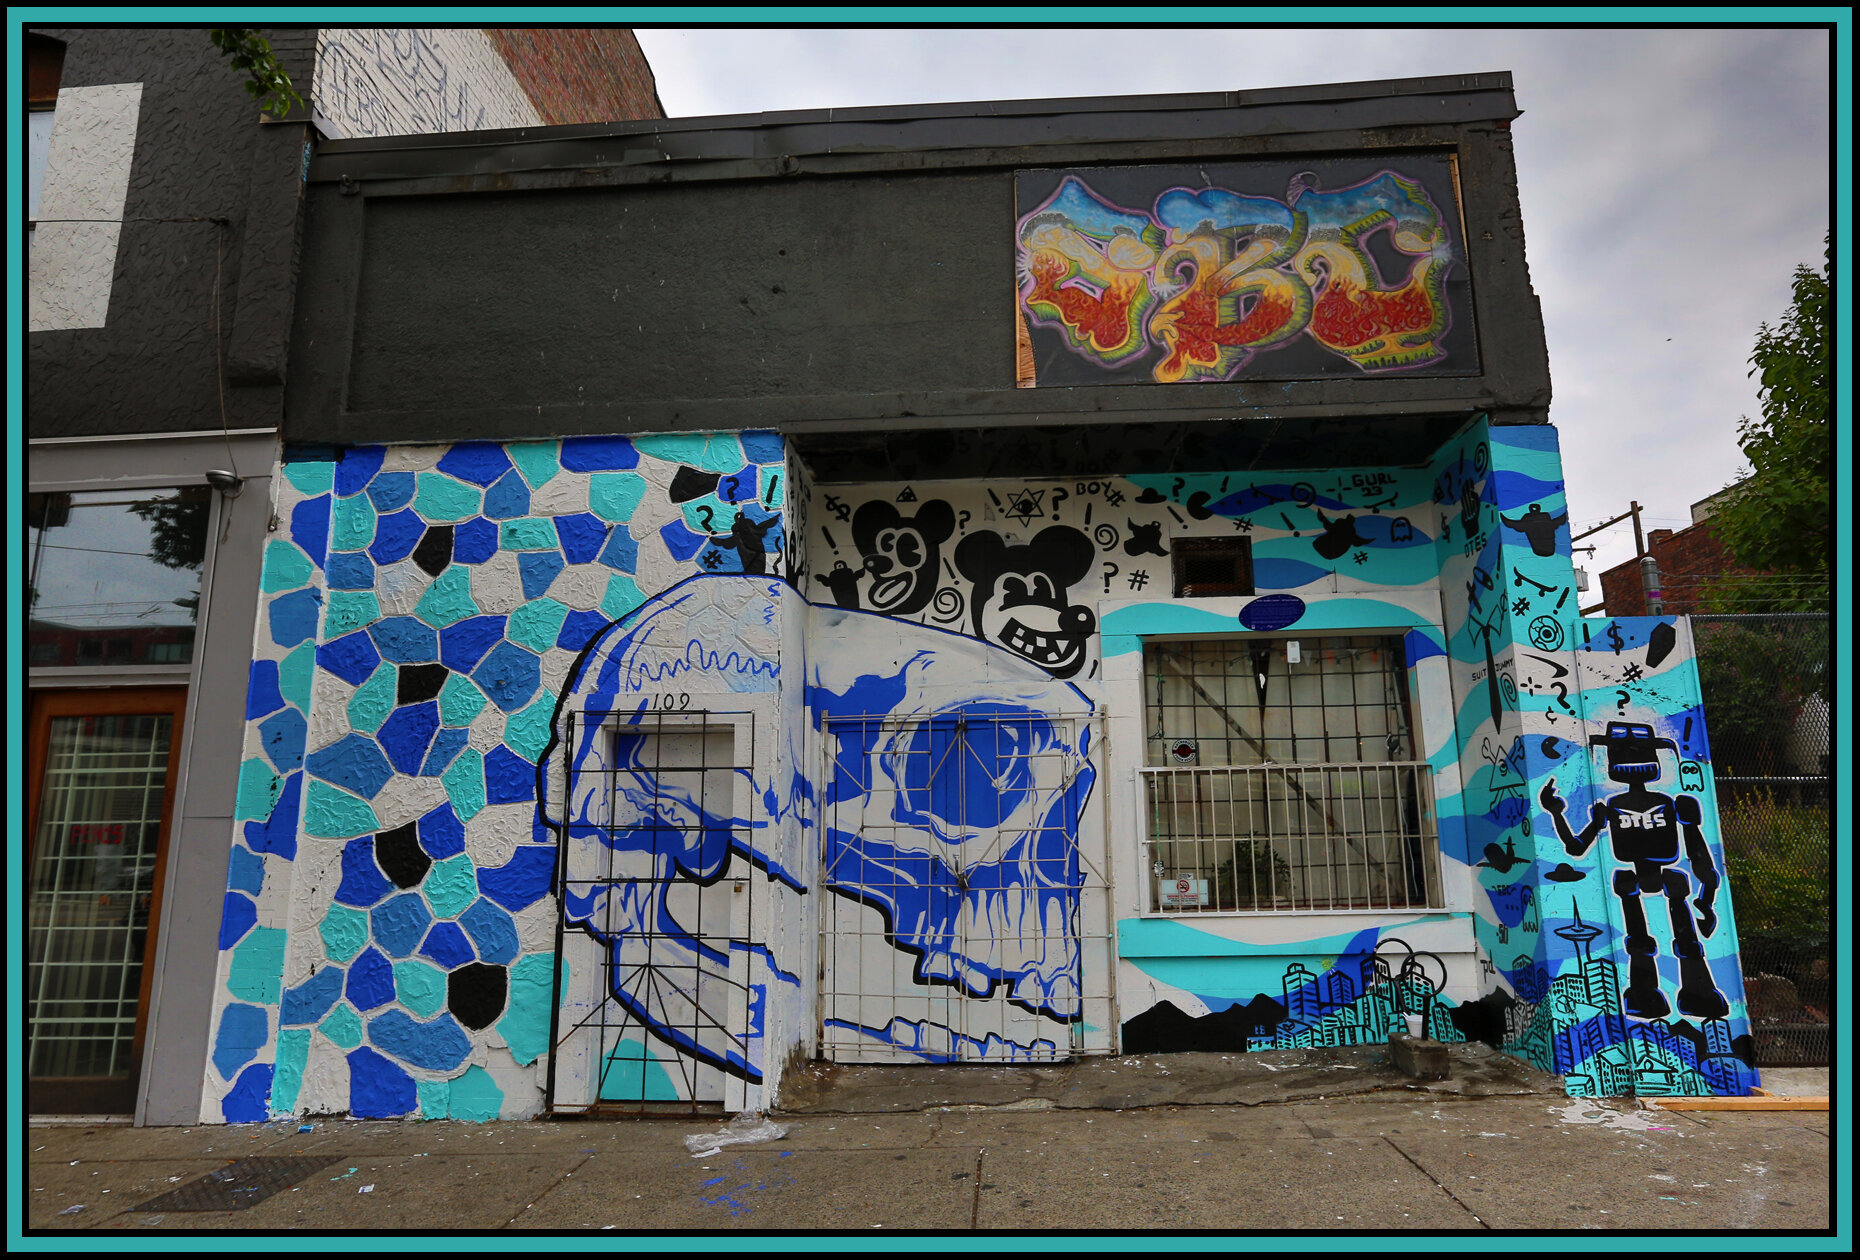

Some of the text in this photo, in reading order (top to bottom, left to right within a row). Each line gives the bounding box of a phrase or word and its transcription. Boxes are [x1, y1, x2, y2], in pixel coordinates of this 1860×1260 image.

[1351, 472, 1398, 488] GURL
[1076, 481, 1112, 499] BOY
[1464, 531, 1488, 558] DTES
[1471, 668, 1487, 682] SUIT
[652, 692, 690, 710] 109
[1618, 811, 1667, 830] DTES
[71, 823, 125, 846] PEN15
